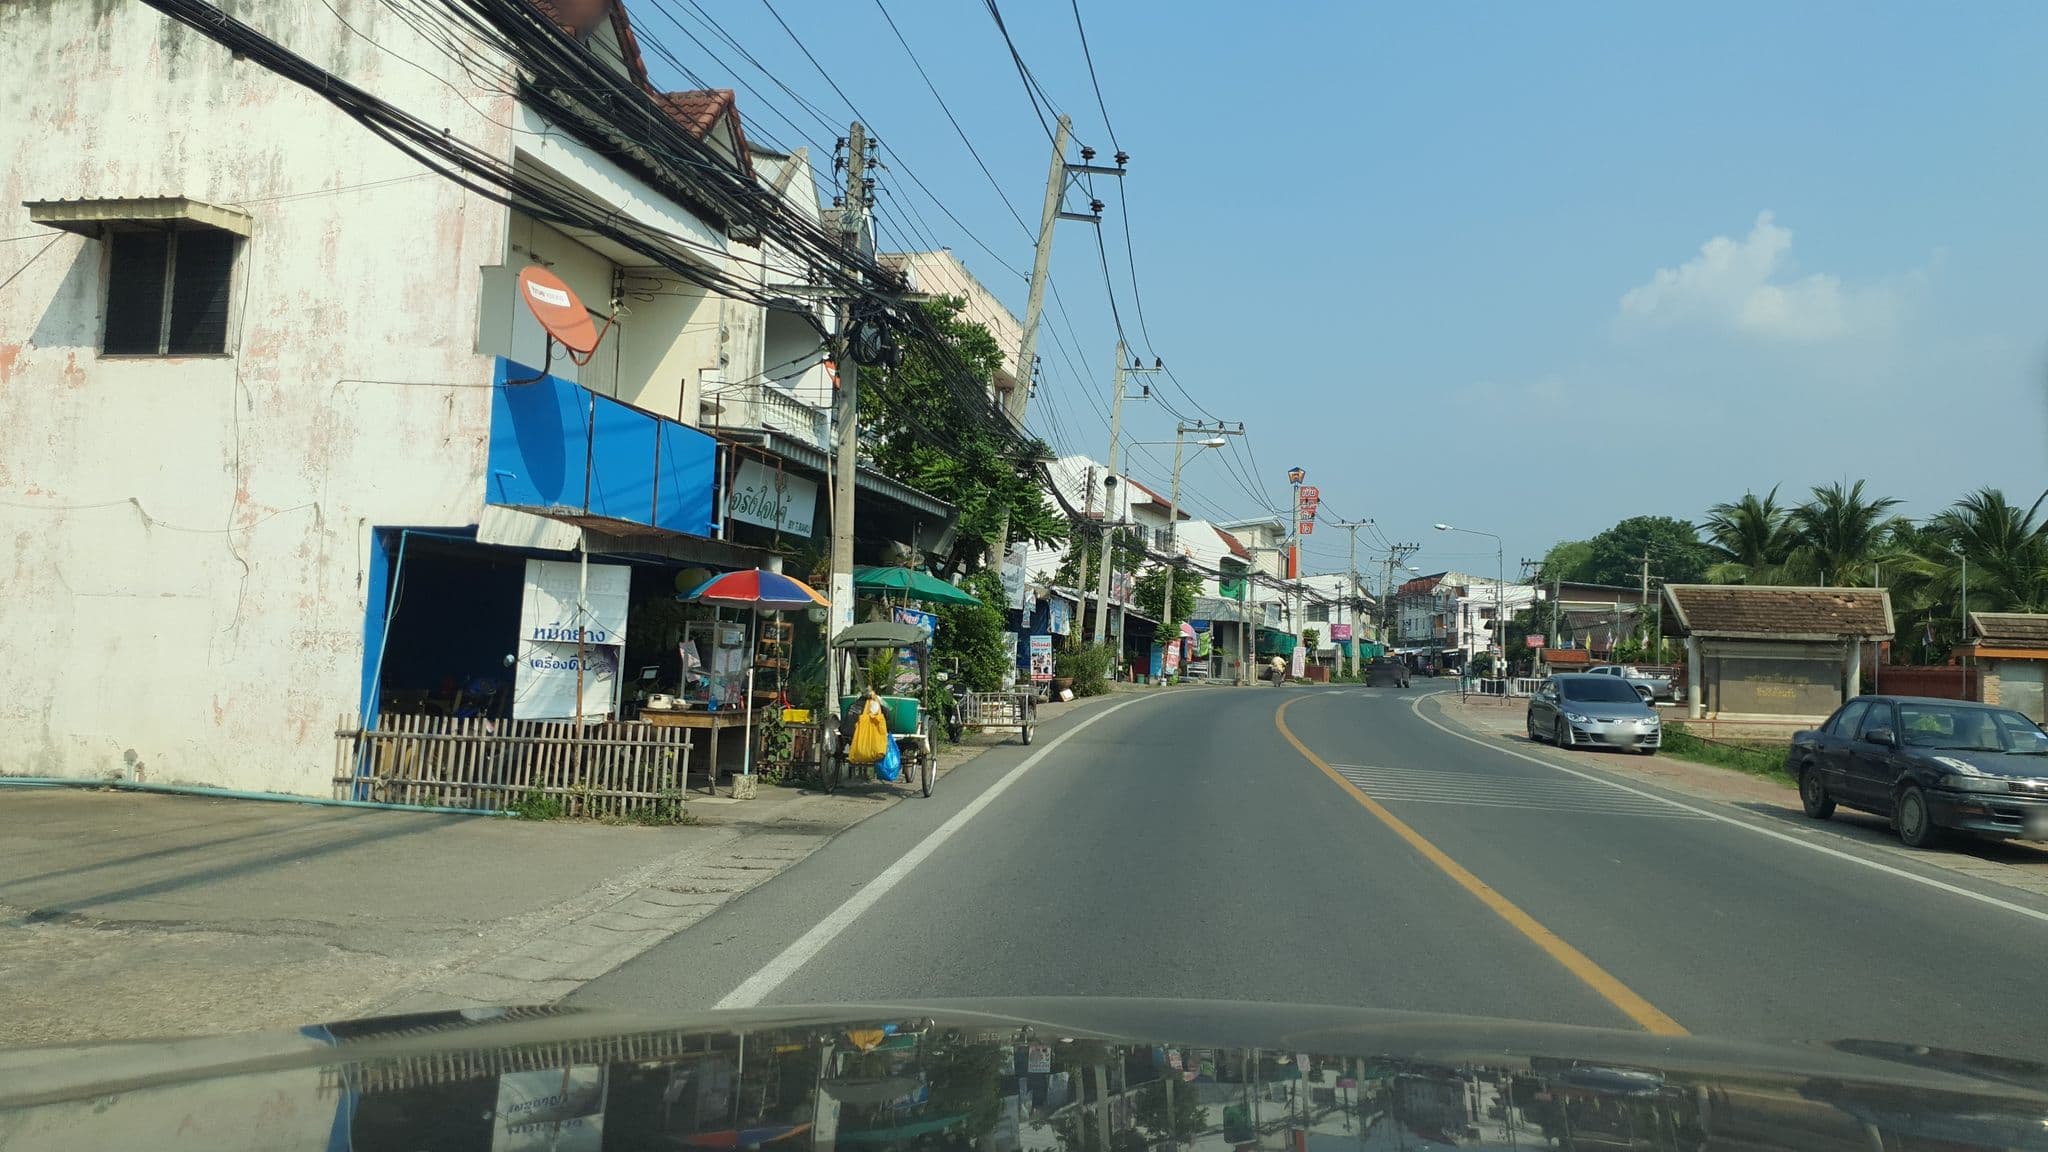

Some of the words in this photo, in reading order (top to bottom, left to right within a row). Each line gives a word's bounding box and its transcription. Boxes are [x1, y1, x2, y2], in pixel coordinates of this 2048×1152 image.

[534, 621, 606, 643] หมึกยาง
[530, 652, 593, 671] เครื่องดืม
